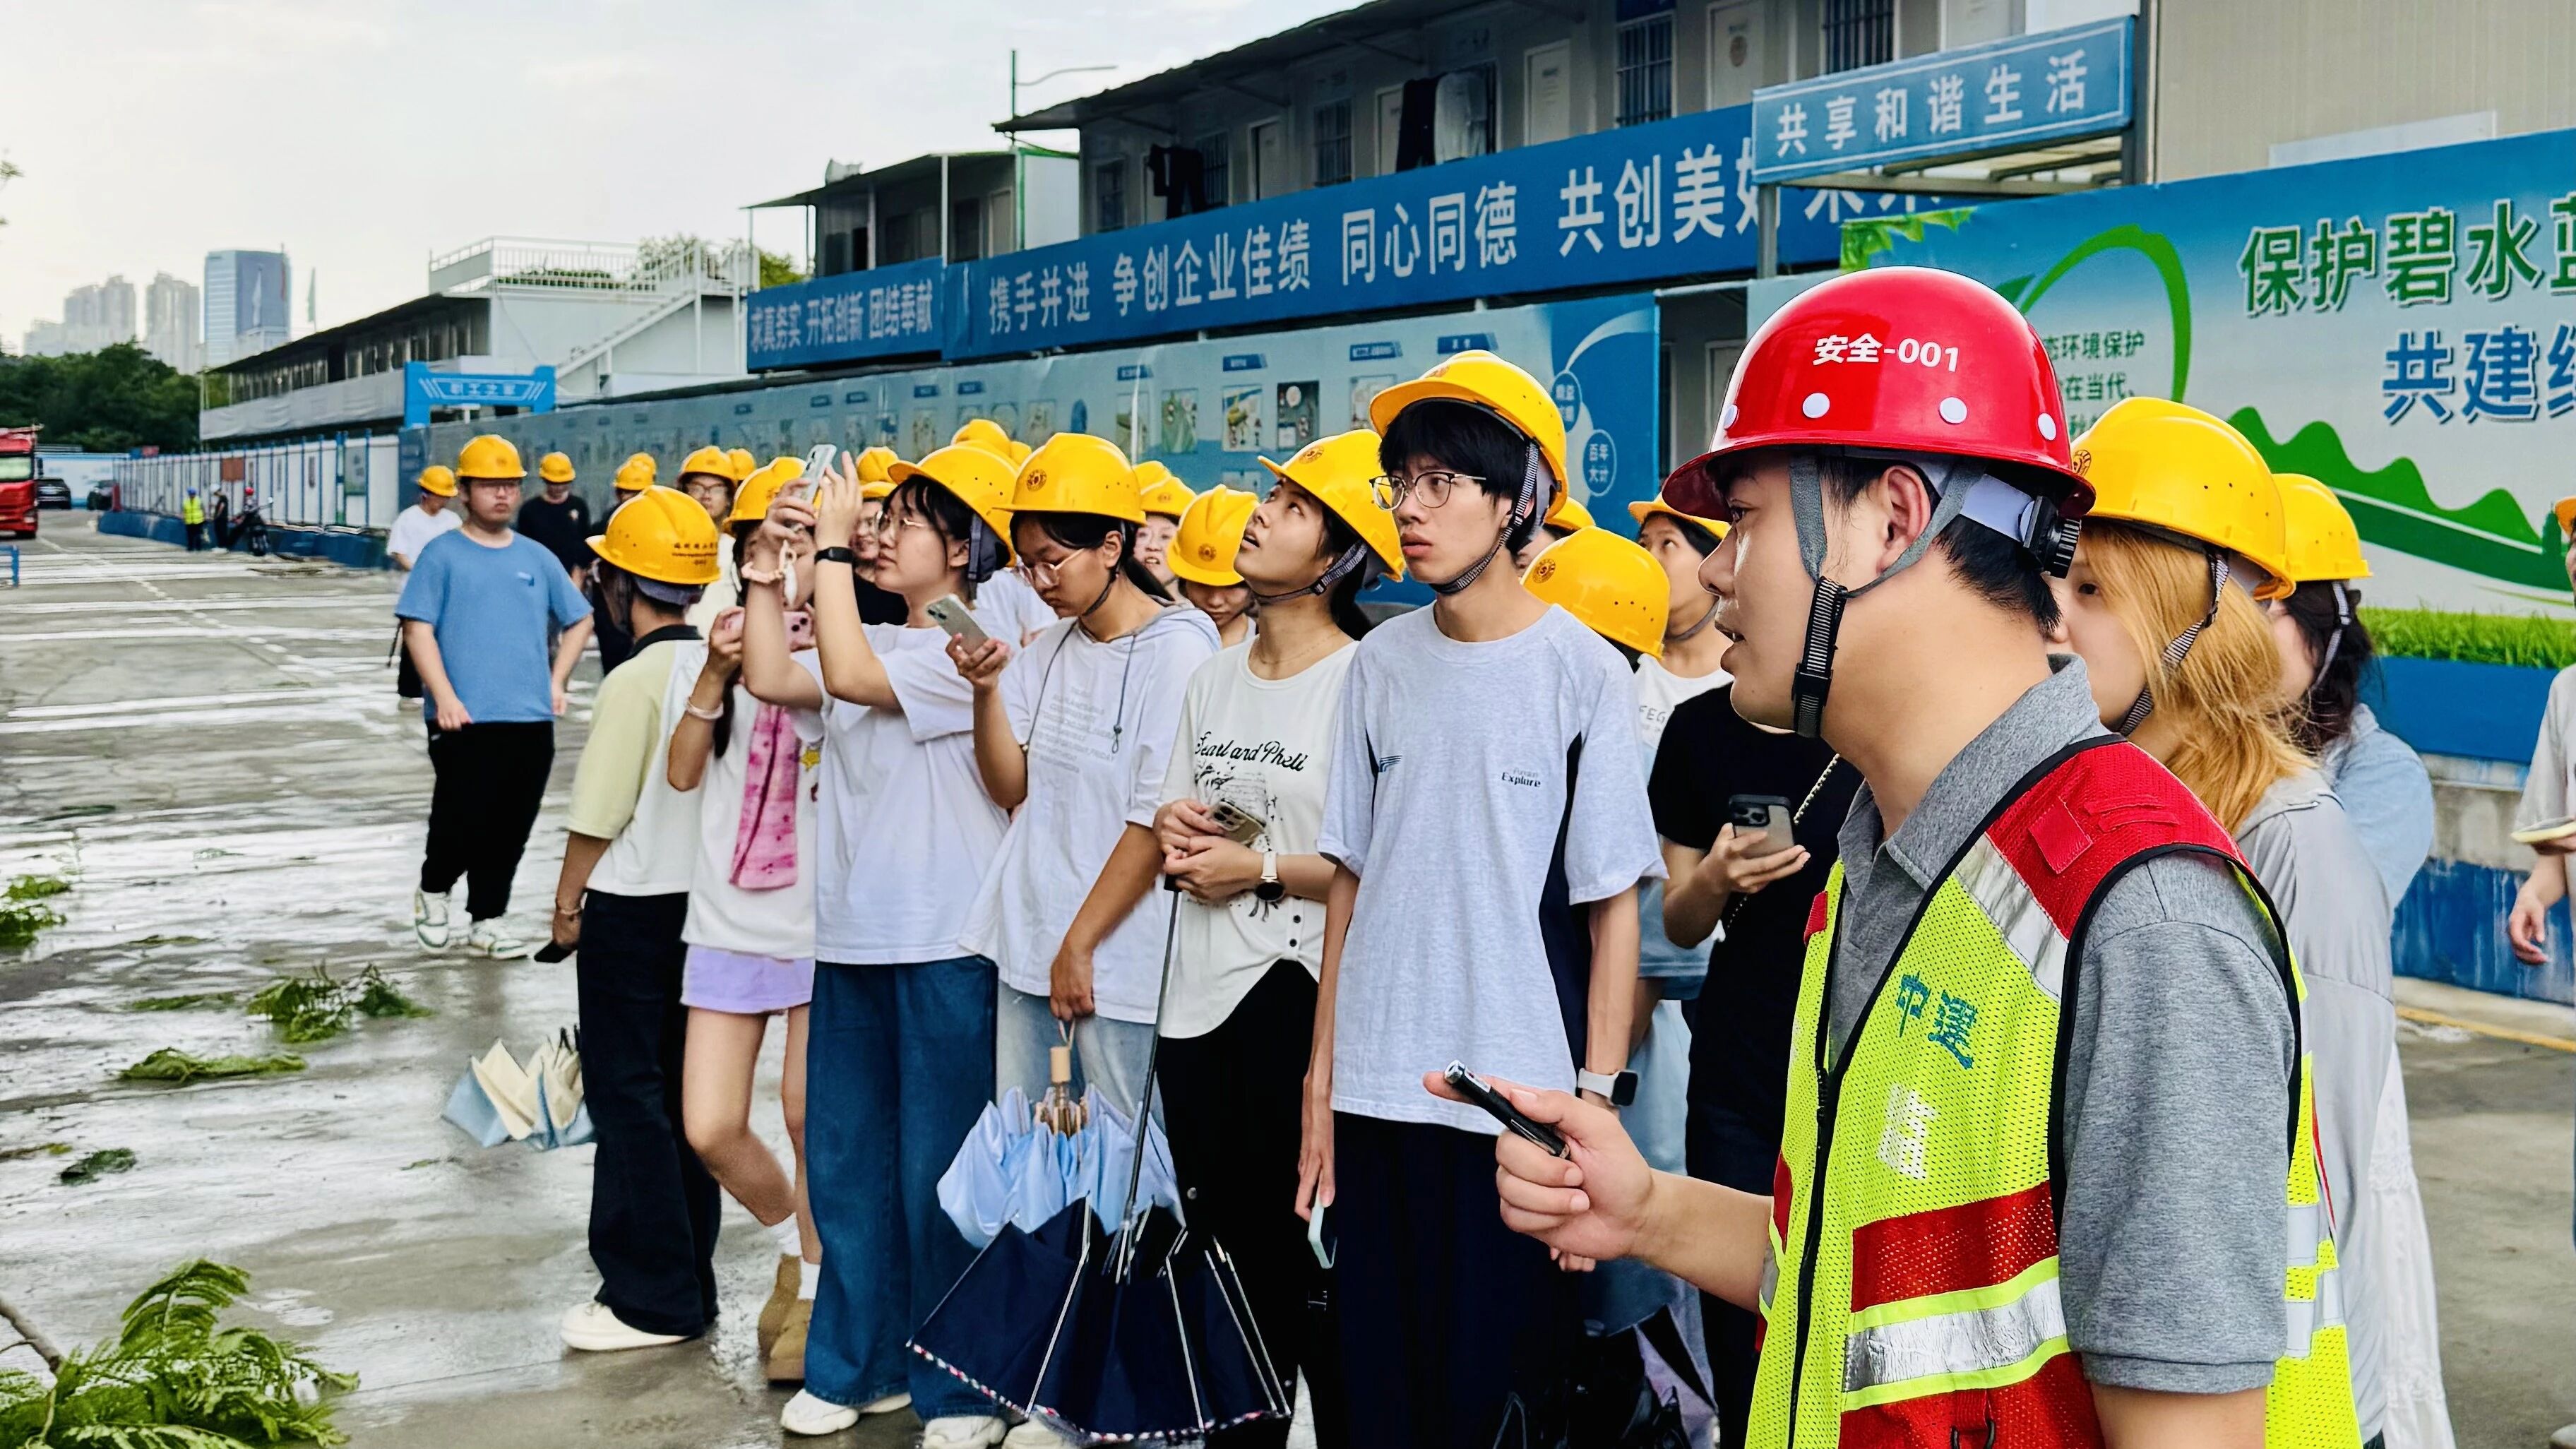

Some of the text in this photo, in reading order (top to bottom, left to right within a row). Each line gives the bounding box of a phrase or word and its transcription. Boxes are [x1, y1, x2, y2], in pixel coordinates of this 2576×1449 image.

[1776, 48, 2089, 159] 共享和谐生活
[989, 261, 1090, 335] 携手并进
[1112, 217, 1311, 318] 争创企业佳绩
[1342, 180, 1517, 286] 同心同德
[806, 290, 864, 347] 开拓创新
[869, 278, 934, 337] 团结奉献
[1812, 332, 1960, 373] 安全-001
[1501, 771, 1542, 788] Explore
